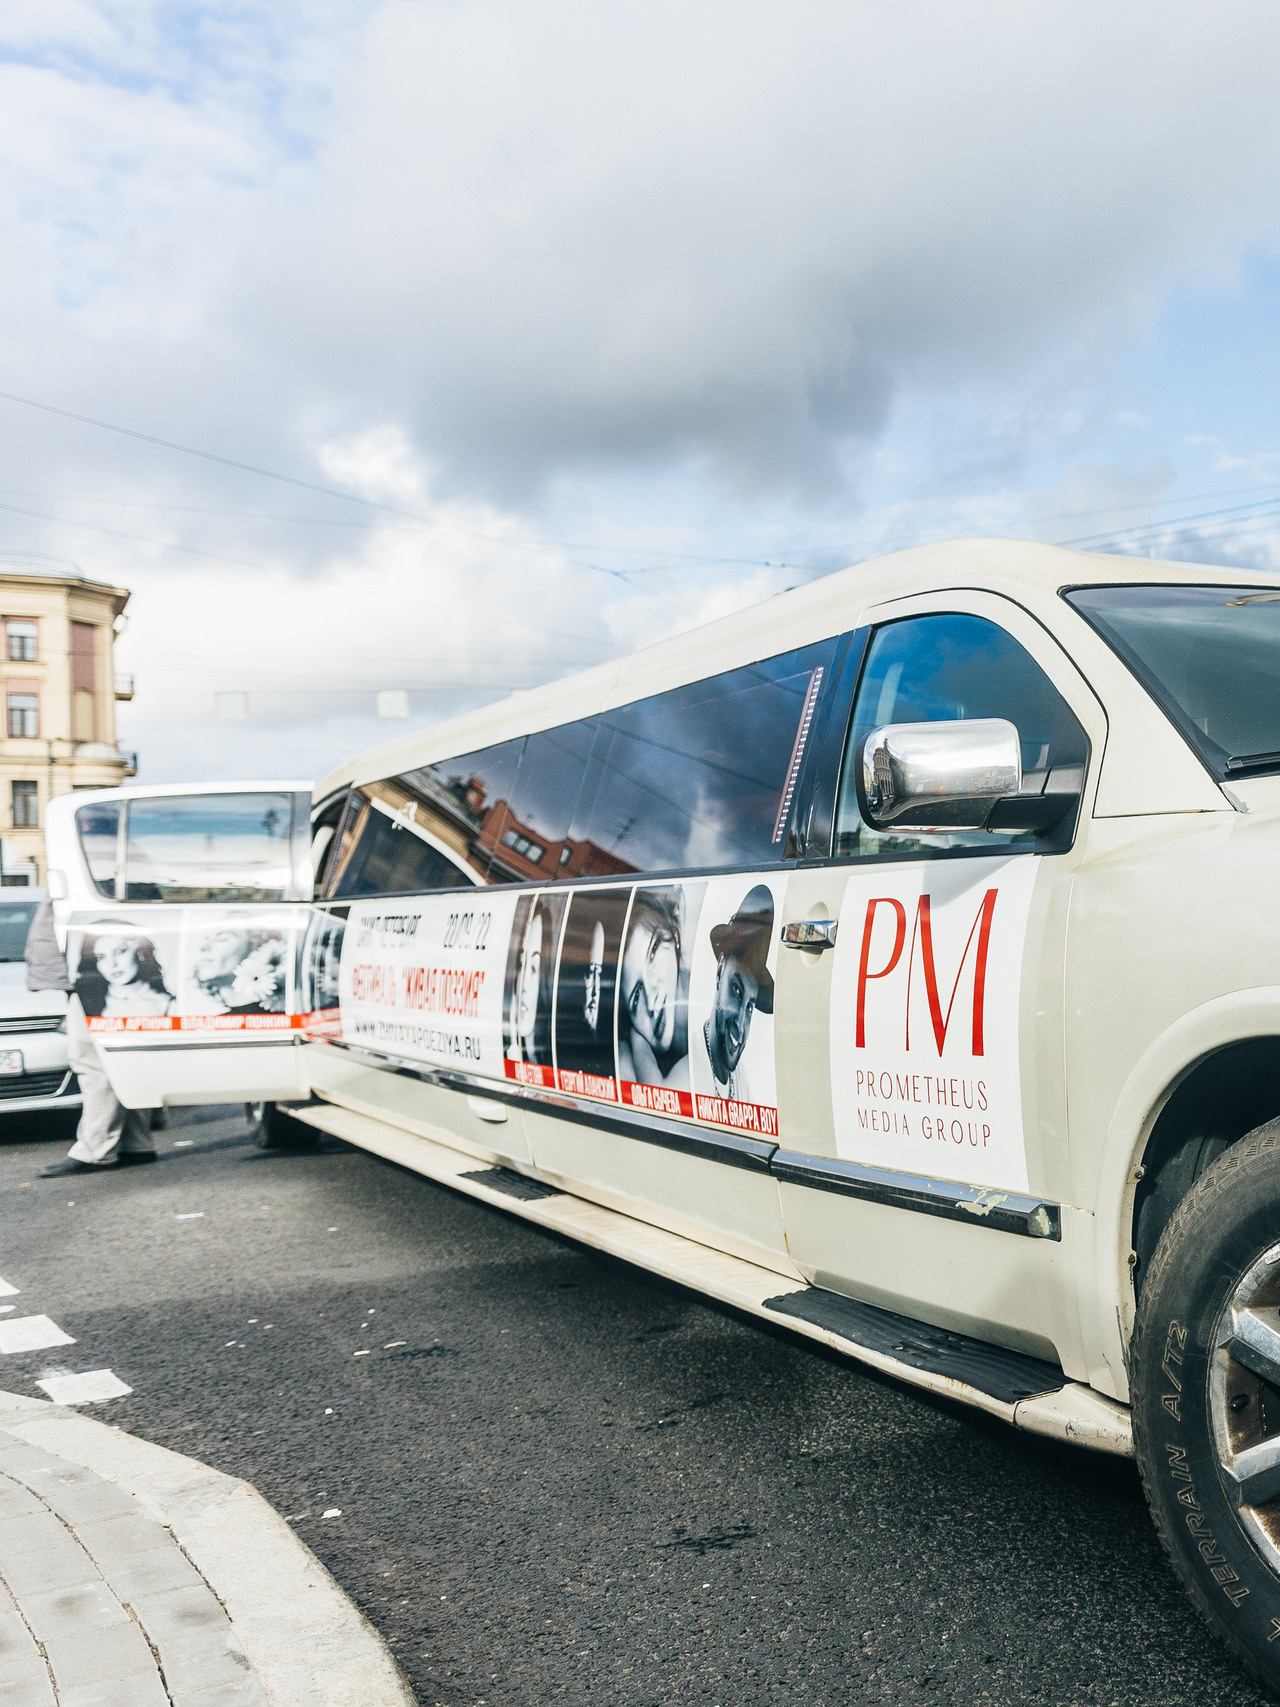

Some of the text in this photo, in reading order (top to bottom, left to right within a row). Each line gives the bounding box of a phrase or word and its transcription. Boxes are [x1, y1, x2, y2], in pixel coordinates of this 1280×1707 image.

[855, 888, 999, 1058] PM
[630, 1083, 654, 1109] ОЛЬГА
[855, 1069, 989, 1111] PROMETHEUS
[697, 1095, 777, 1135] НИКИТА GRAPPA BOY
[857, 1108, 991, 1147] MEDIA GROUP
[1161, 1443, 1250, 1609] TERRAIN
